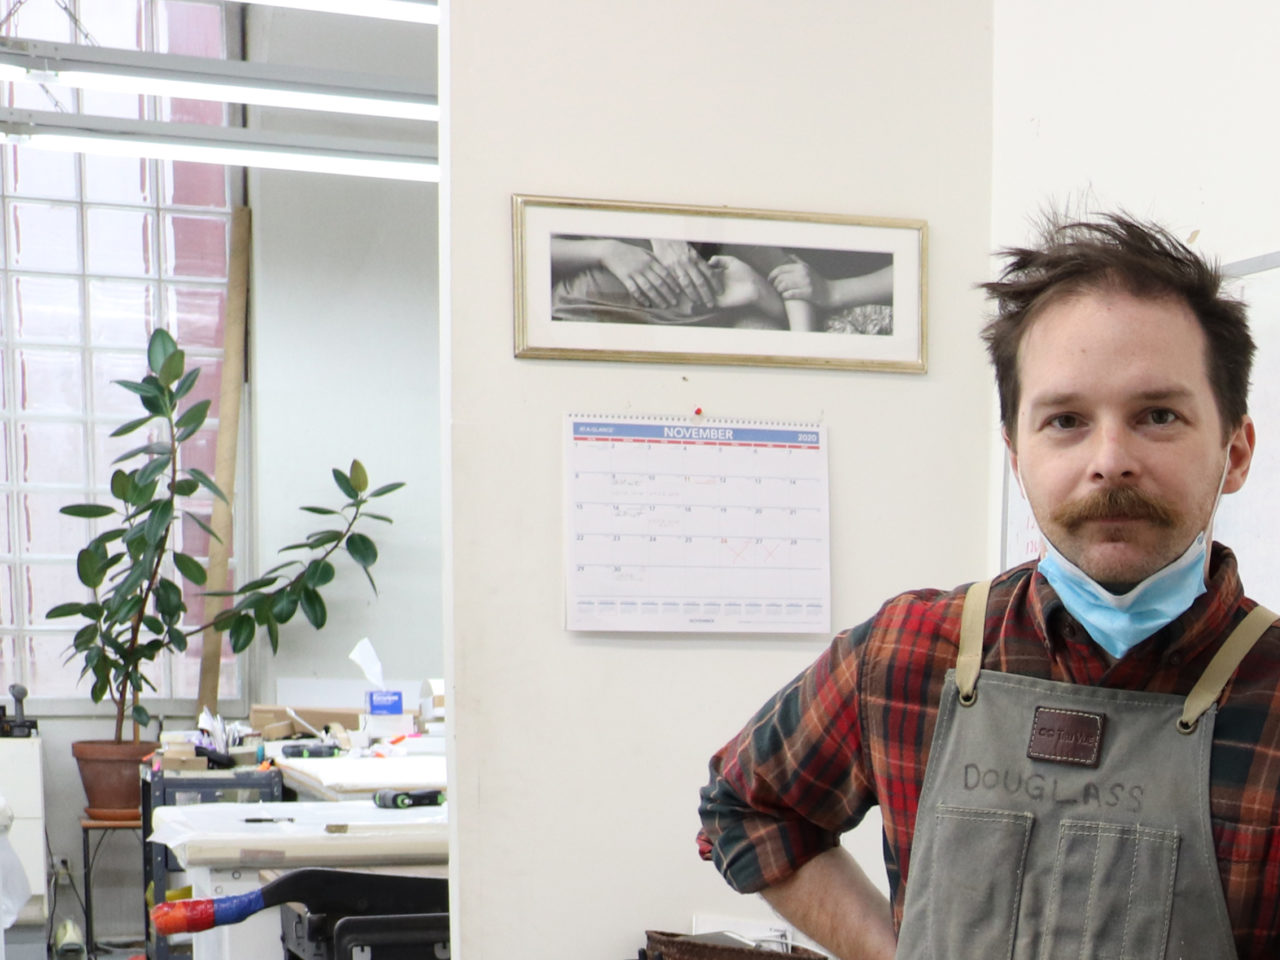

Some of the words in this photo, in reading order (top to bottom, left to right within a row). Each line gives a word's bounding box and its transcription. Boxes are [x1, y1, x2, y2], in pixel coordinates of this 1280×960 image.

[663, 426, 734, 440] NOVEMBER
[797, 433, 817, 442] 2020
[963, 763, 1144, 813] DOUGLASS
